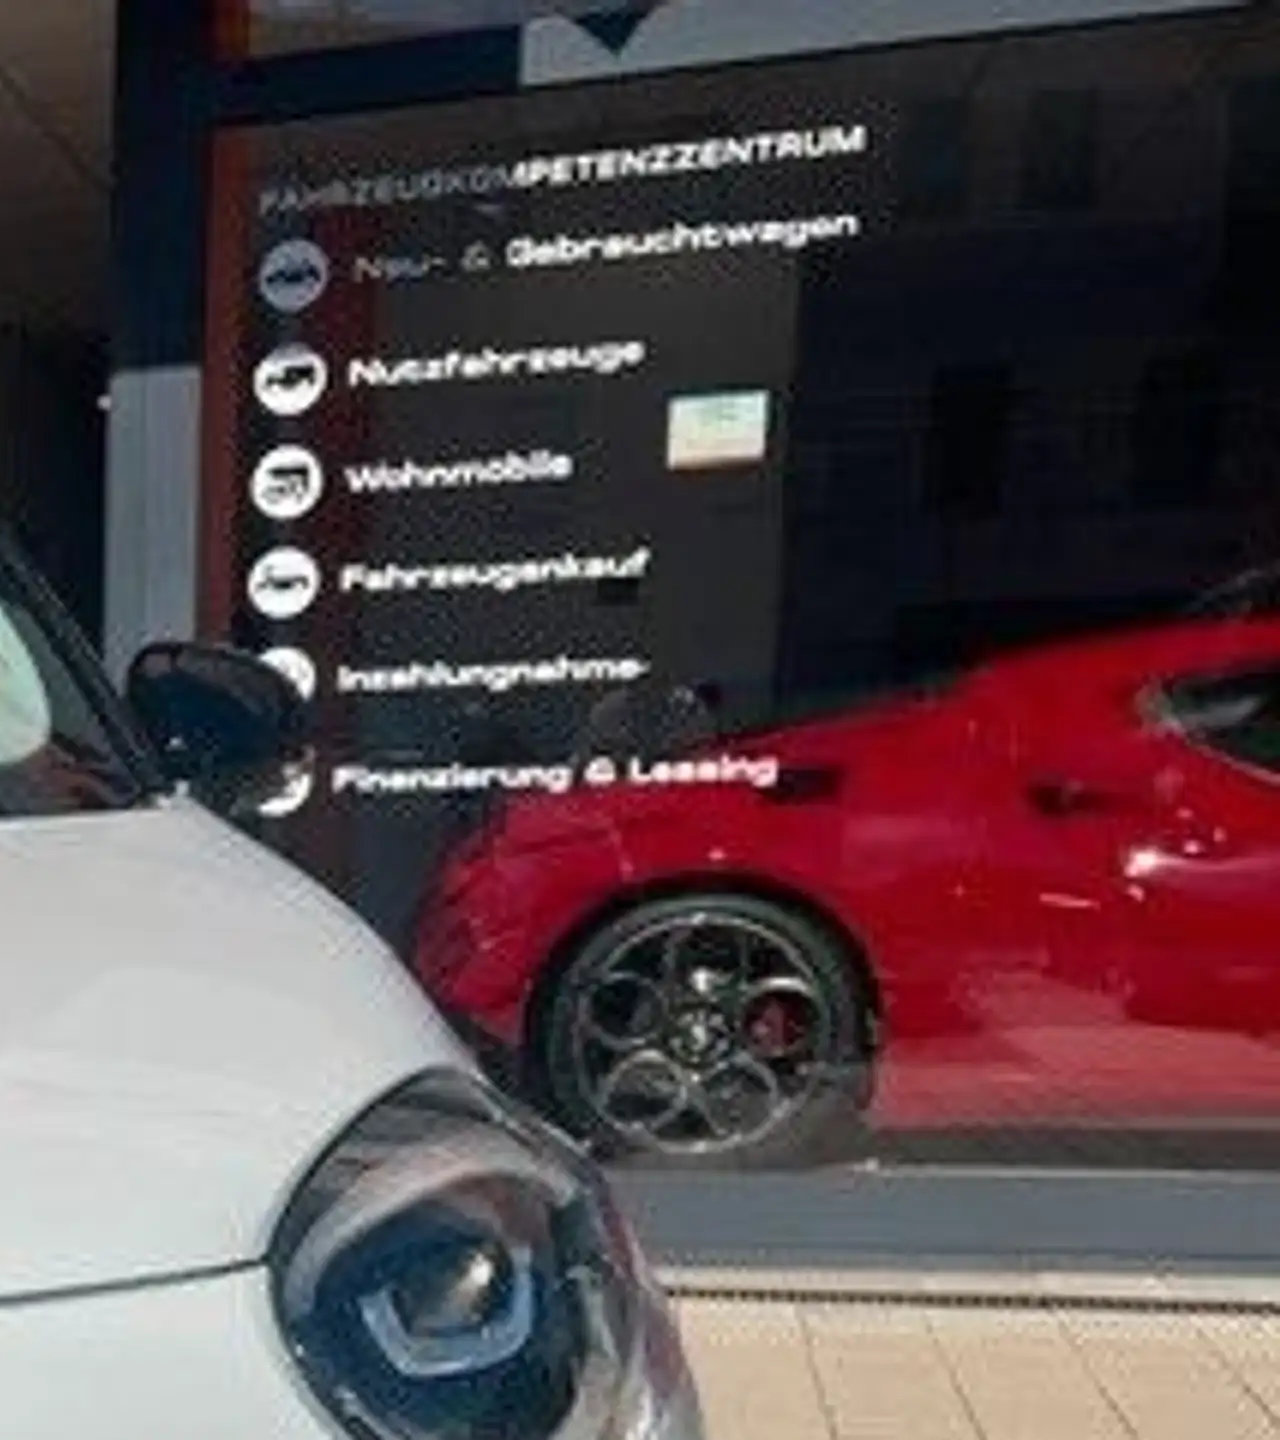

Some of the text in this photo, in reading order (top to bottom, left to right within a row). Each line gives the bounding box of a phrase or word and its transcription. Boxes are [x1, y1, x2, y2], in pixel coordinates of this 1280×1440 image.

[505, 214, 860, 267] Gebrauchtwagen
[348, 340, 645, 387] Nutzfahrzeuge
[344, 448, 573, 492] Wohnmobile
[331, 754, 780, 794] Finanzierung & Leasing
